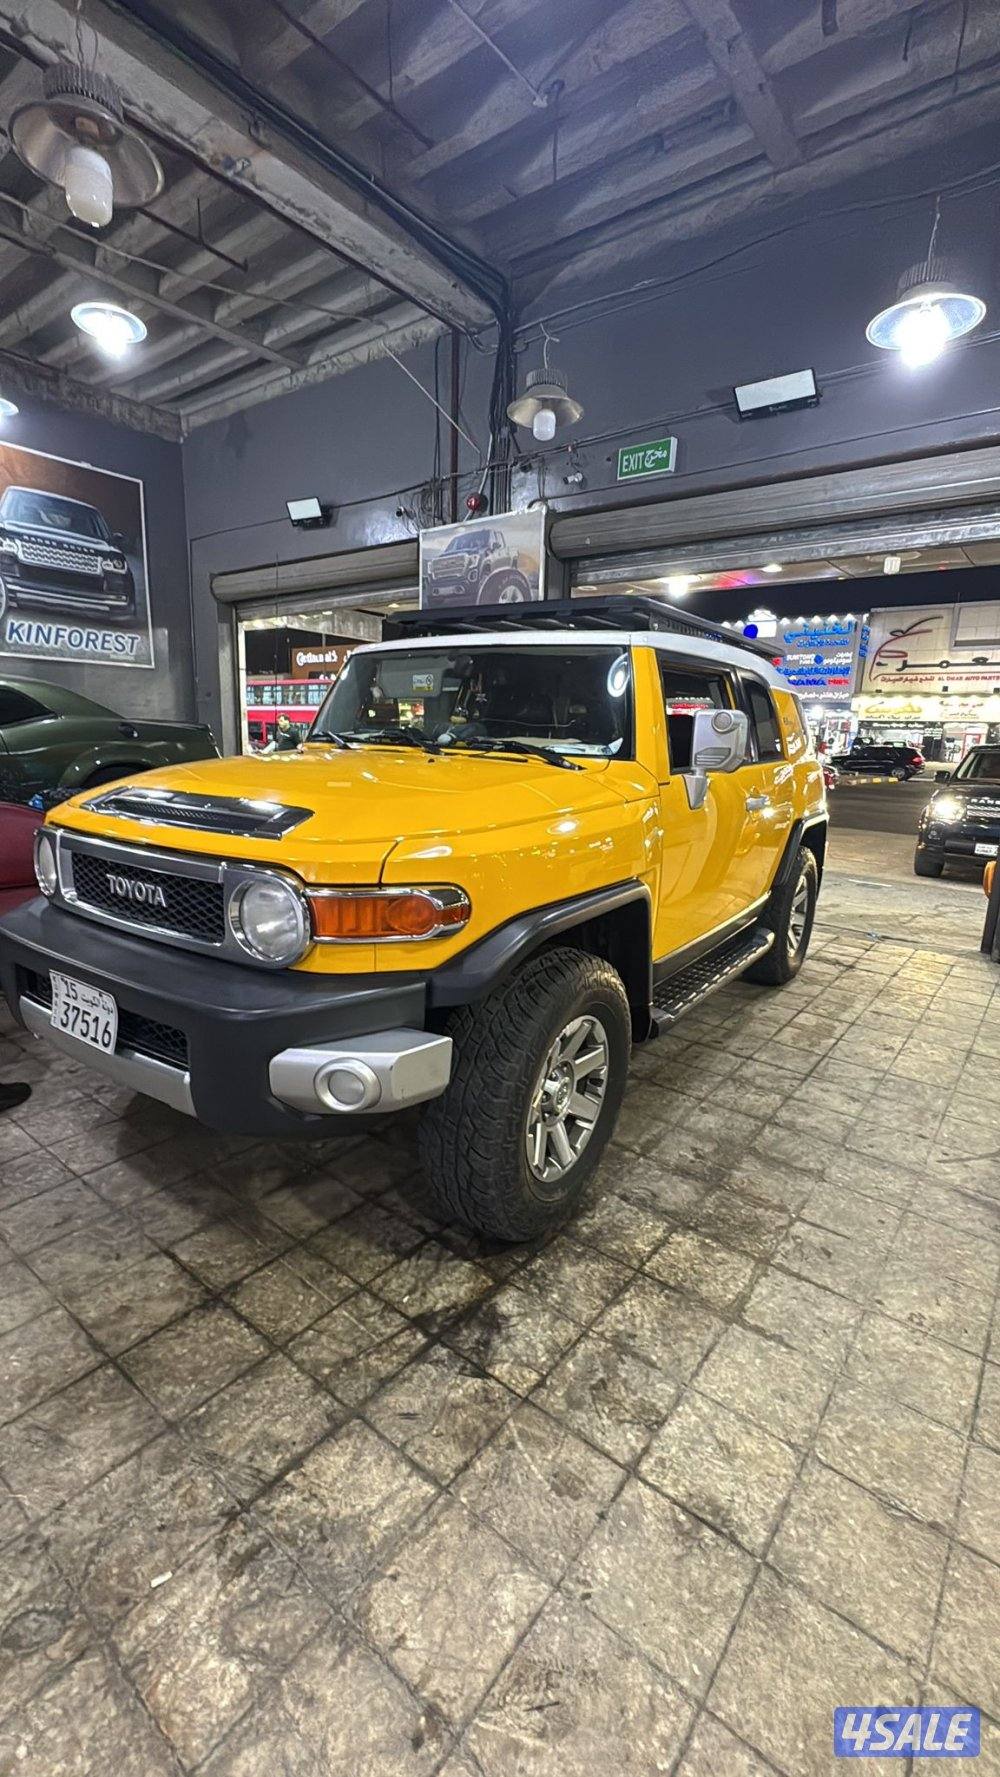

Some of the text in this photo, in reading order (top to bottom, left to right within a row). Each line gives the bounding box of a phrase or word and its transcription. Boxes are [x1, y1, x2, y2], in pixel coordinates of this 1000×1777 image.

[623, 452, 644, 472] EXIT
[645, 447, 668, 468] مخرج
[7, 621, 139, 653] KINFOREST
[106, 874, 167, 907] TOYOTA
[64, 980, 78, 1000] 15
[60, 1001, 111, 1048] 37516
